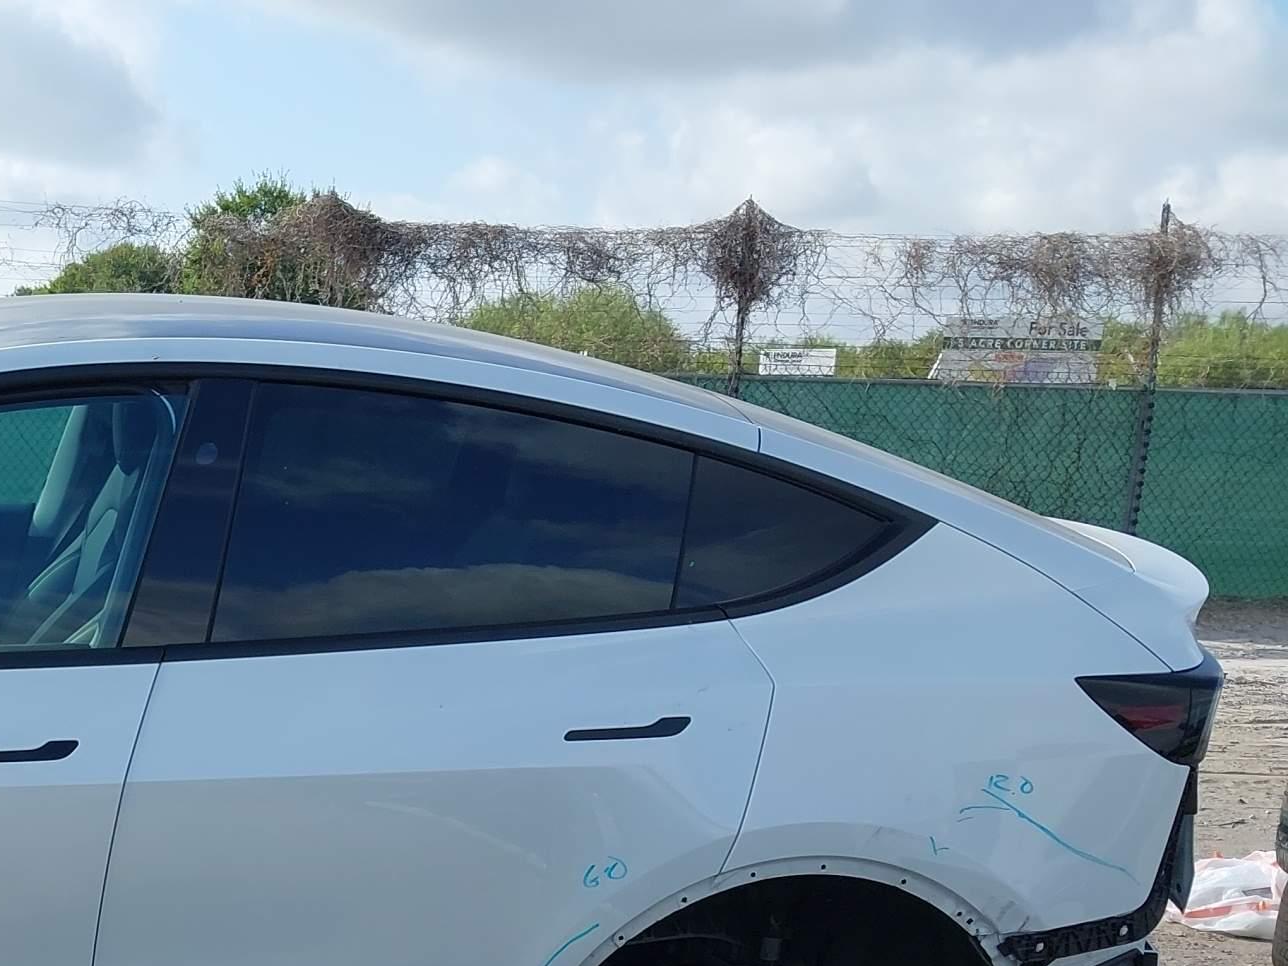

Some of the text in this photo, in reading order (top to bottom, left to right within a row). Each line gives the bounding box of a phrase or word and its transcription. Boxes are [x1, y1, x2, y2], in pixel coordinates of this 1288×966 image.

[1029, 321, 1089, 337] For Sale
[969, 338, 1001, 349] ACRE
[1007, 339, 1056, 350] CORNER
[1062, 340, 1087, 350] SITE
